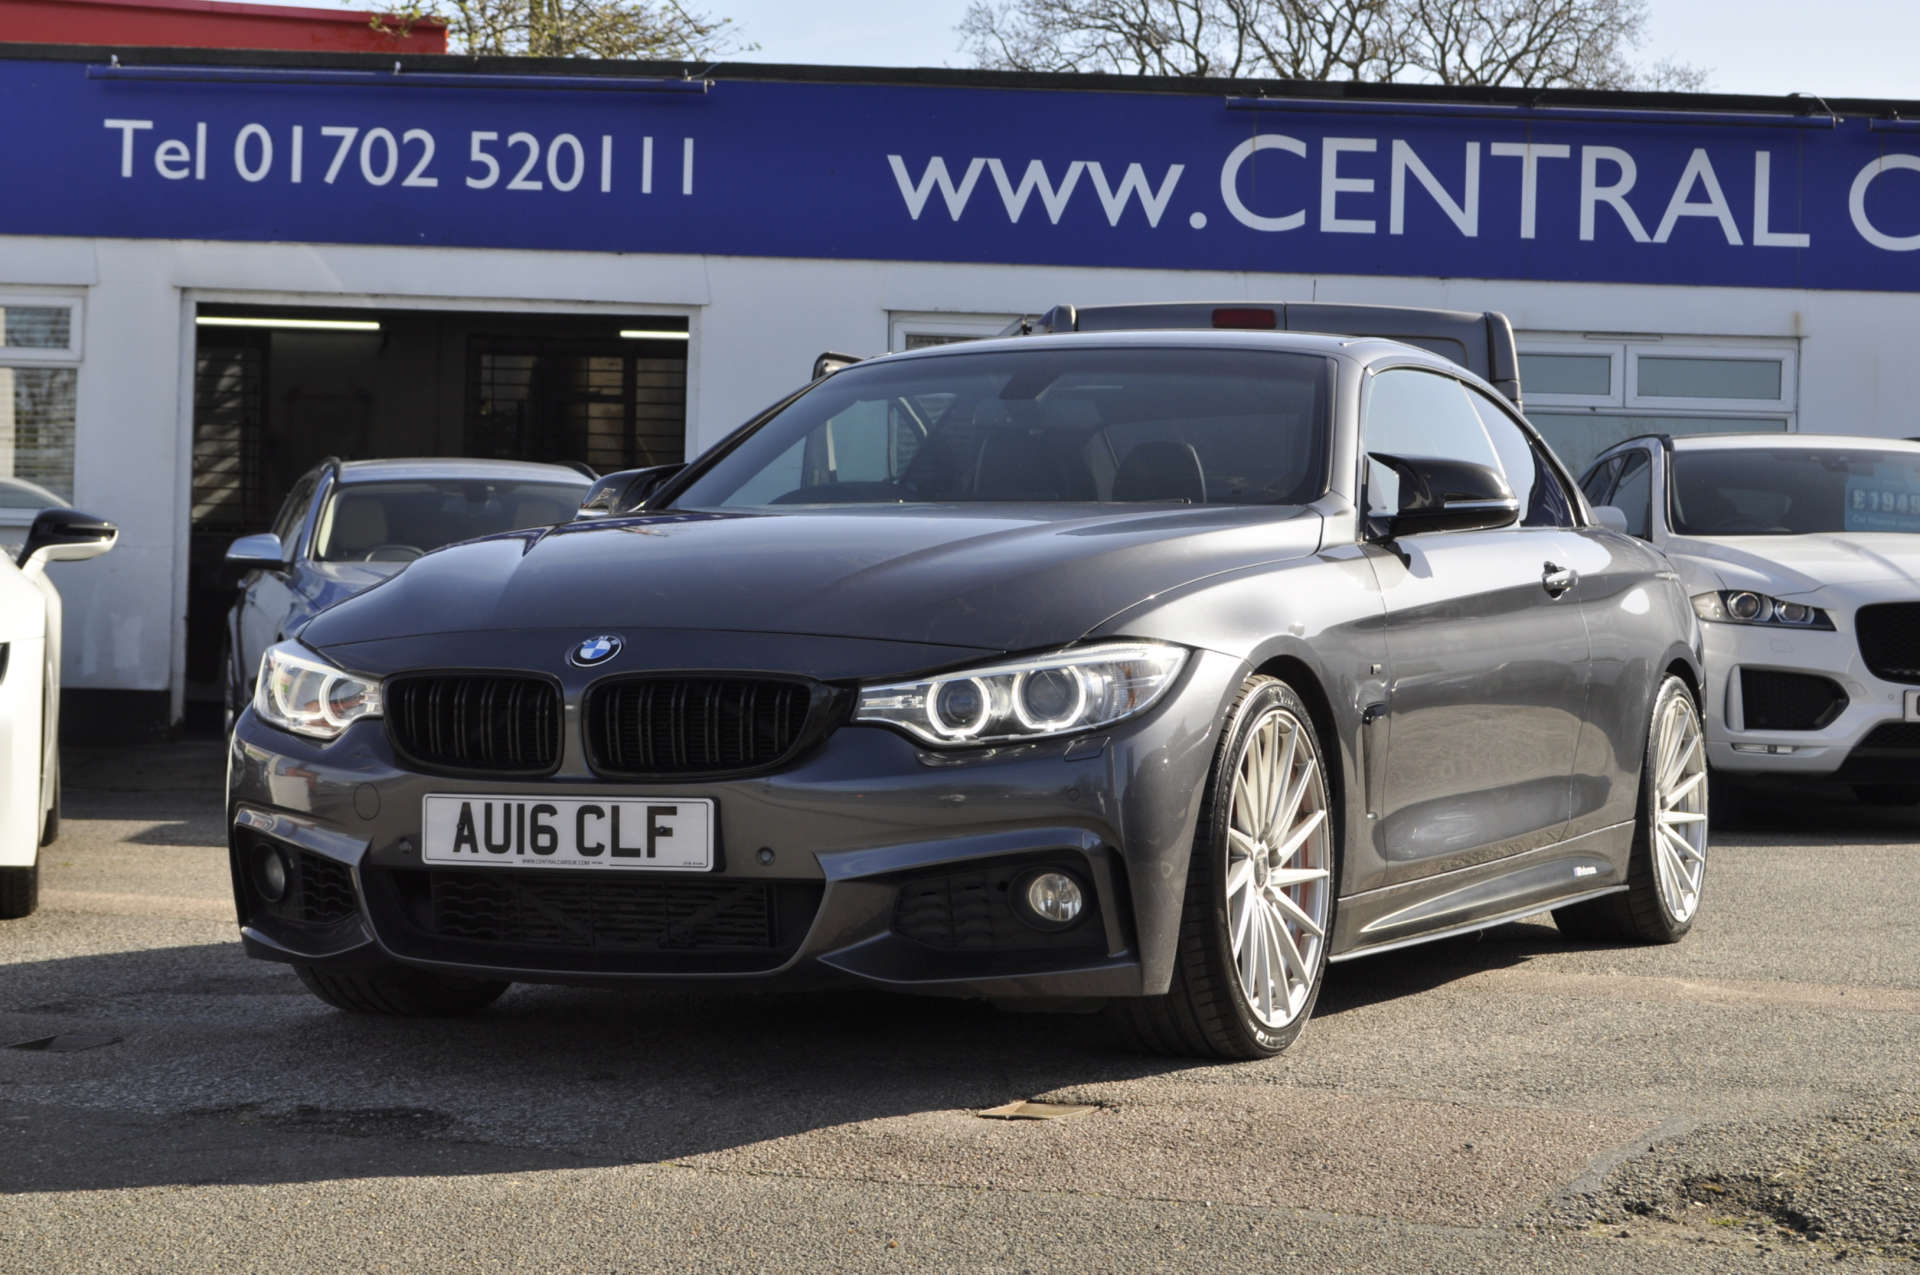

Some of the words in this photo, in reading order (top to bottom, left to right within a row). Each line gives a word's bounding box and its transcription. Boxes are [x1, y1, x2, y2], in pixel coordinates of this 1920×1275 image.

[103, 118, 207, 180] Tel
[234, 123, 439, 188] 01702
[465, 131, 694, 195] 520111
[452, 801, 559, 856] AU16
[575, 804, 678, 859] CLF
